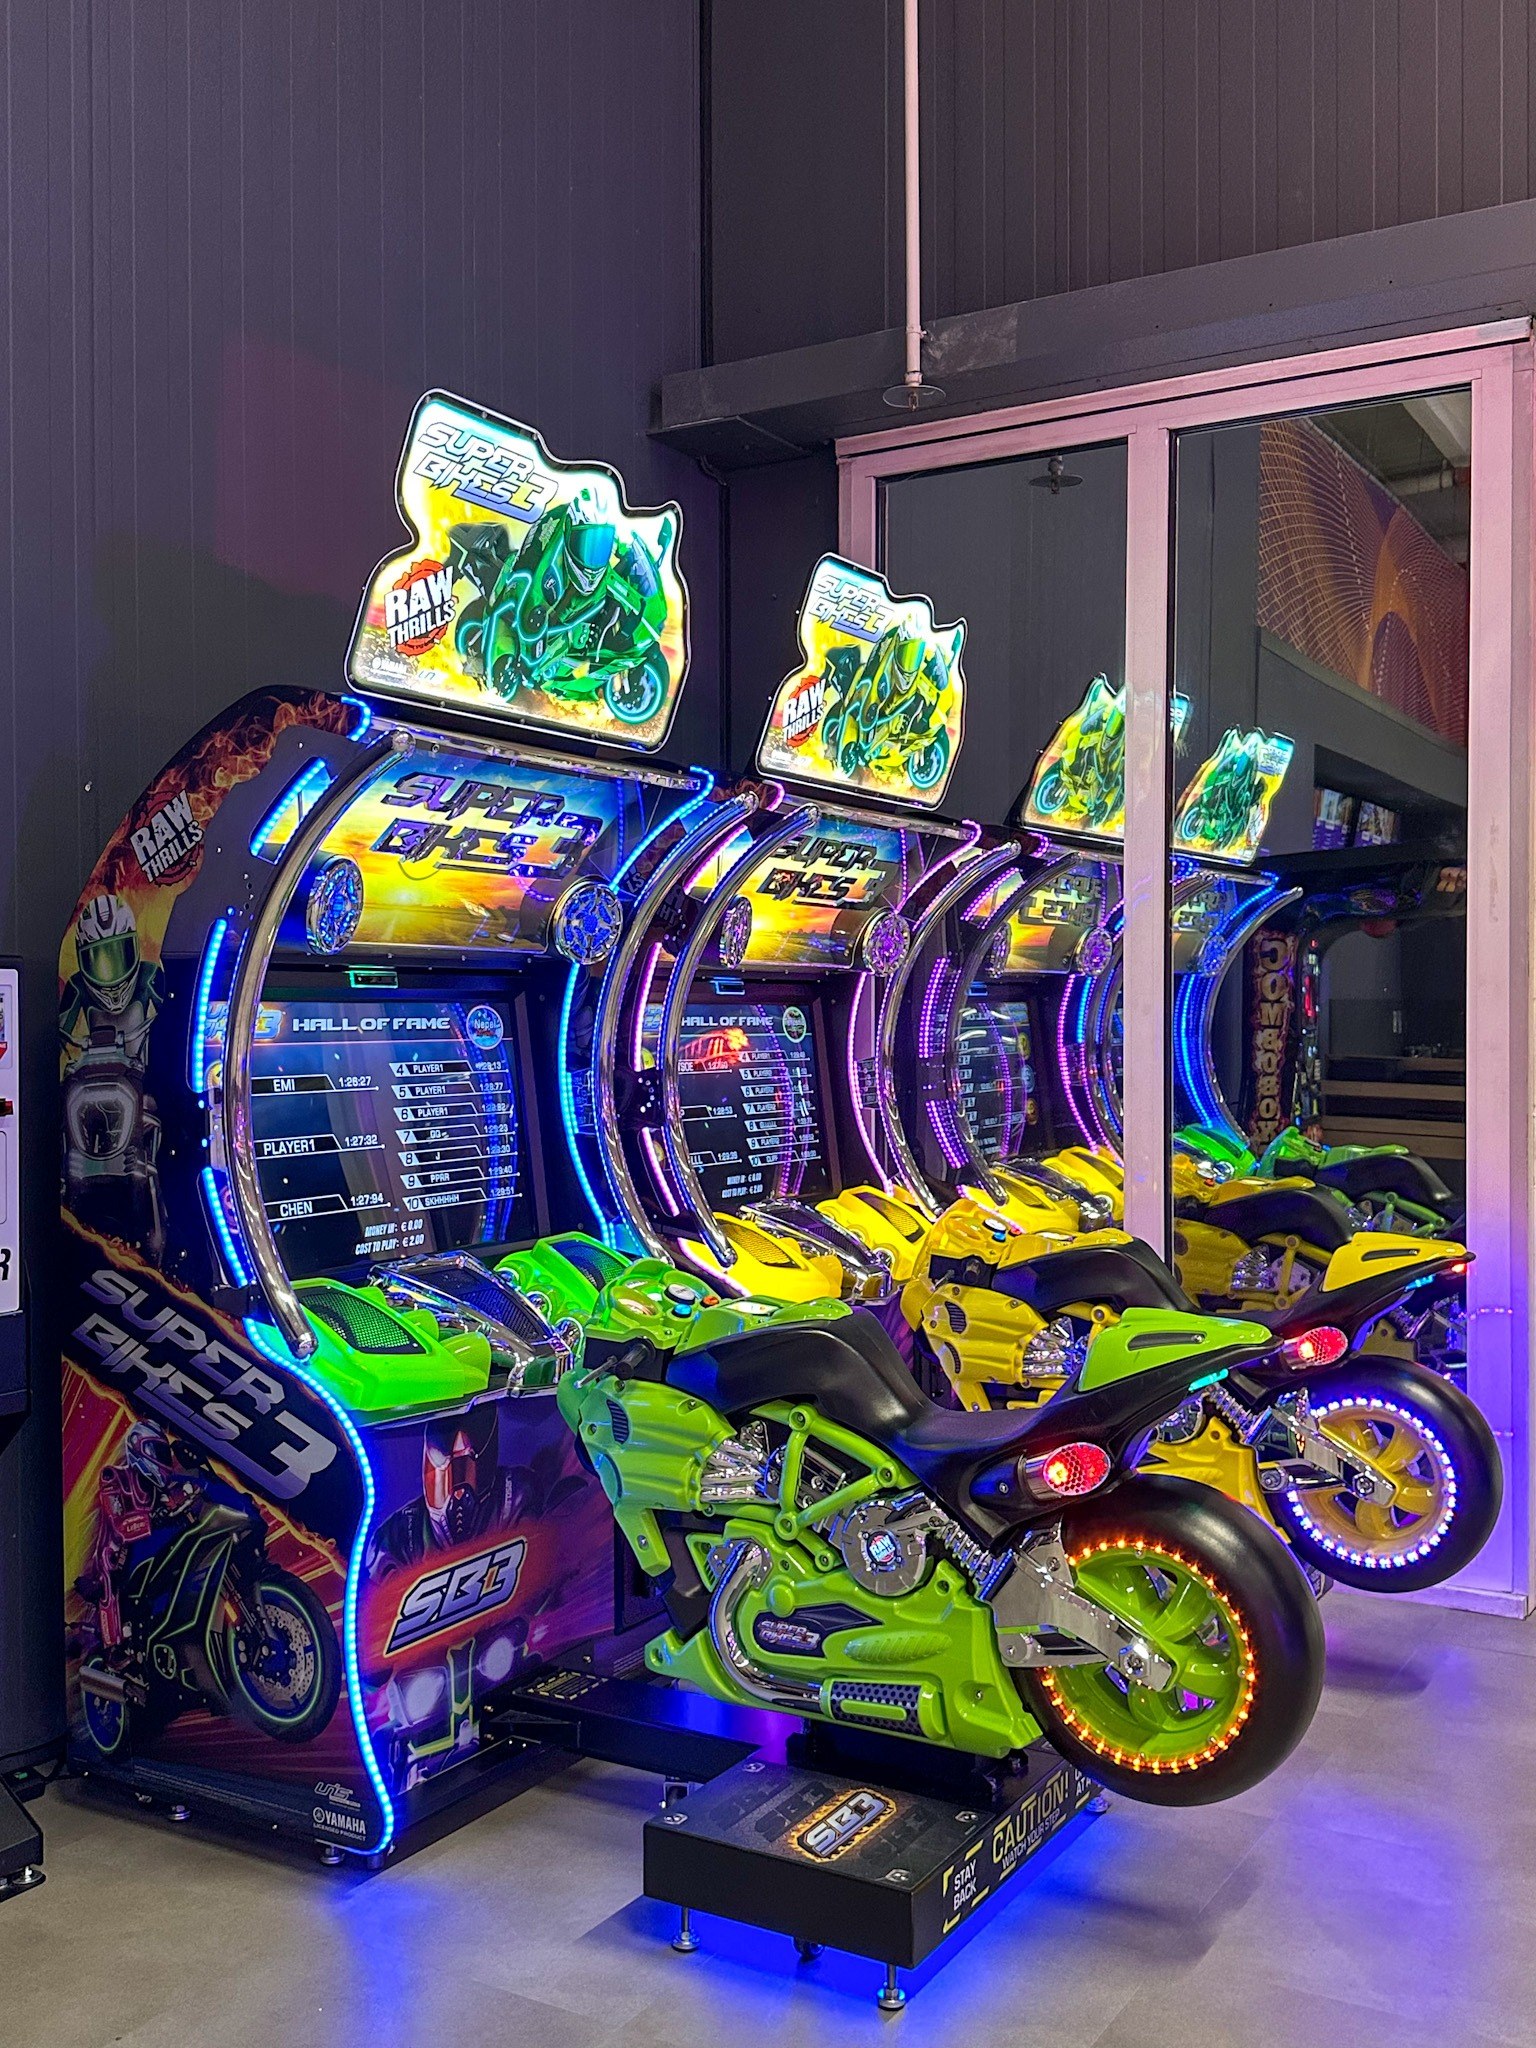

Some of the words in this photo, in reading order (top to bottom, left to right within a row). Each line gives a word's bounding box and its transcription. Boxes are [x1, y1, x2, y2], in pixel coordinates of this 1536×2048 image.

[418, 421, 536, 485] SUPER
[413, 452, 521, 512] BIKES
[383, 564, 454, 628] RAW
[813, 574, 882, 613] SUPER
[386, 600, 457, 651] THRILLS
[808, 596, 870, 632] BIKES
[782, 678, 827, 727] RAW
[782, 704, 825, 742] THRILLS
[380, 771, 566, 828] SUPER
[130, 789, 195, 866] RAW
[369, 817, 538, 865] BIKES
[142, 819, 204, 883] THRILLS
[769, 834, 878, 872] SUPER
[292, 1018, 357, 1031] HALL
[360, 1017, 390, 1031] OF
[392, 1016, 450, 1030] FAME
[681, 1016, 718, 1027] HALL
[719, 1016, 738, 1027] OF
[738, 1015, 774, 1027] FAME
[273, 1078, 296, 1092] EMI
[339, 1076, 371, 1087] 1:26:27
[396, 1064, 404, 1075] 4
[412, 1064, 444, 1073] PLAYER1
[399, 1086, 407, 1098] 5
[415, 1085, 446, 1096] PLAYER1
[401, 1108, 409, 1120] 6
[417, 1107, 448, 1117] PLAYER1
[263, 1139, 315, 1156] PLAYER1
[344, 1134, 378, 1147] 1:27:32
[403, 1130, 411, 1142] 7
[405, 1152, 413, 1164] 8
[407, 1175, 415, 1187] 9
[280, 1201, 313, 1217] CHEN
[407, 1198, 419, 1209] 10
[355, 1242, 373, 1256] COST
[372, 1240, 381, 1253] TO
[409, 1234, 425, 1246] 2.00
[364, 1223, 388, 1238] MONEY
[80, 1269, 285, 1415] SUPER
[71, 1312, 254, 1441] BIKES
[271, 1410, 338, 1500] 3
[385, 1540, 526, 1656] SB3
[325, 1810, 366, 1834] YAMAHA
[804, 1789, 888, 1858] SB3
[992, 1771, 1070, 1865] CAUTION!
[1001, 1840, 1028, 1871] WATCH
[1027, 1826, 1046, 1850] YOUR
[1045, 1808, 1061, 1831] STEP
[953, 1858, 978, 1892] STAY
[953, 1878, 978, 1912] BACK
